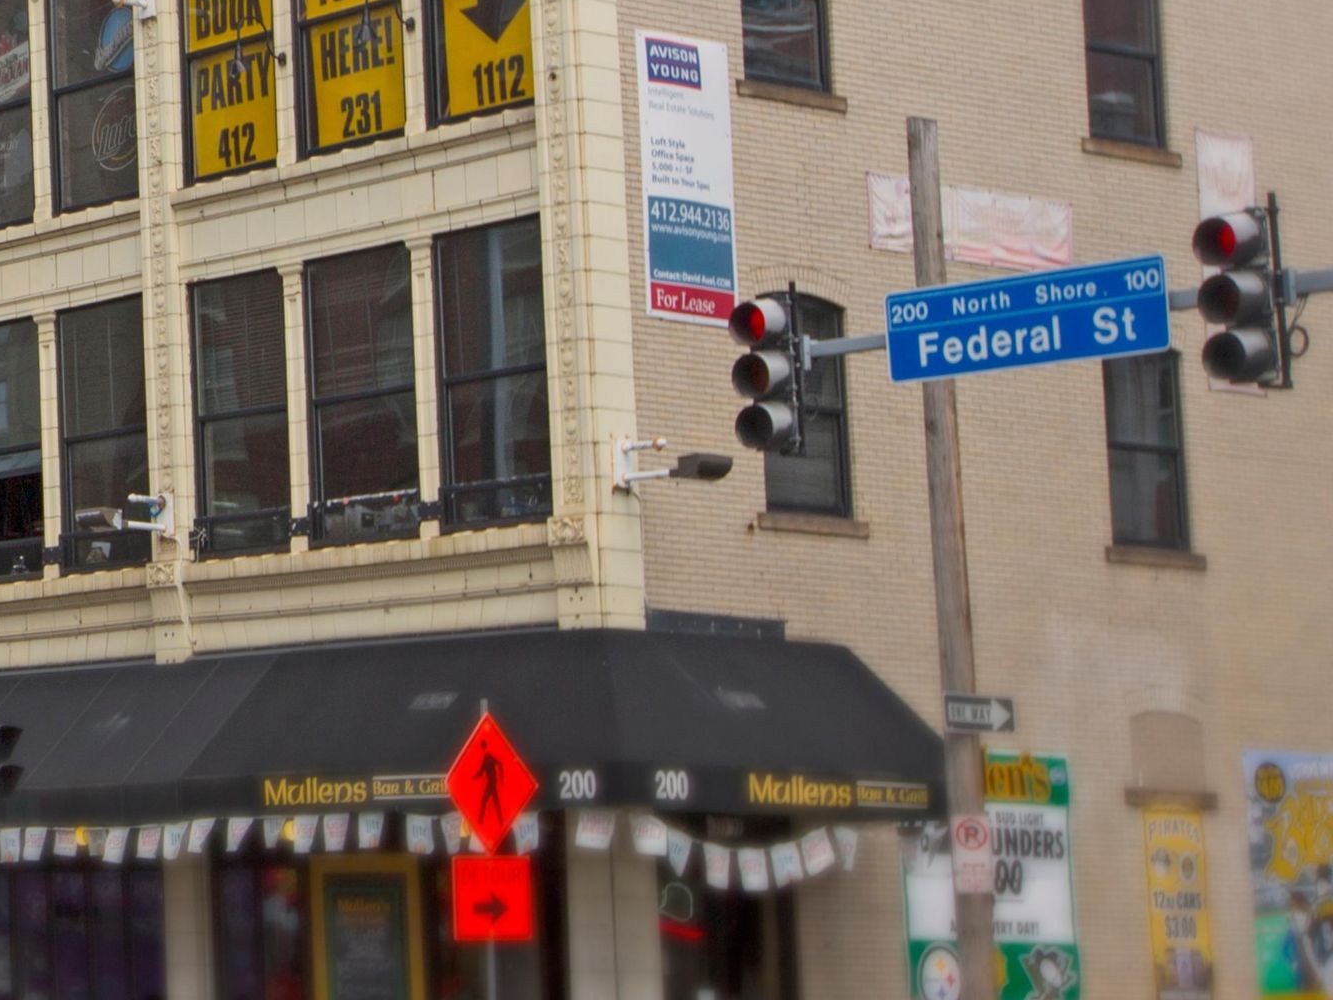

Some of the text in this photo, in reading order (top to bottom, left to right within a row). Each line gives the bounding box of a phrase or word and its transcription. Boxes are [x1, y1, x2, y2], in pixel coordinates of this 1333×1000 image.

[320, 15, 396, 82] HERE!
[649, 44, 698, 65] AVISON
[196, 51, 272, 115] PARTY
[472, 54, 526, 107] 1112
[650, 62, 699, 83] YOUNG
[340, 90, 384, 139] 231
[218, 122, 257, 169] 412
[651, 136, 685, 150] Loft Style
[651, 148, 695, 164] Office Space
[650, 200, 730, 232] 412.944.2136
[655, 287, 716, 315] For Lease
[891, 267, 1160, 325] 200 North Shore 100
[918, 306, 1137, 368] Federal St
[264, 775, 367, 806] Mullens
[373, 779, 400, 796] Bar
[404, 779, 414, 795] &
[559, 770, 597, 800] 200
[654, 769, 690, 801] 200
[748, 773, 852, 807] Mullens
[461, 865, 523, 885] DETOUR
